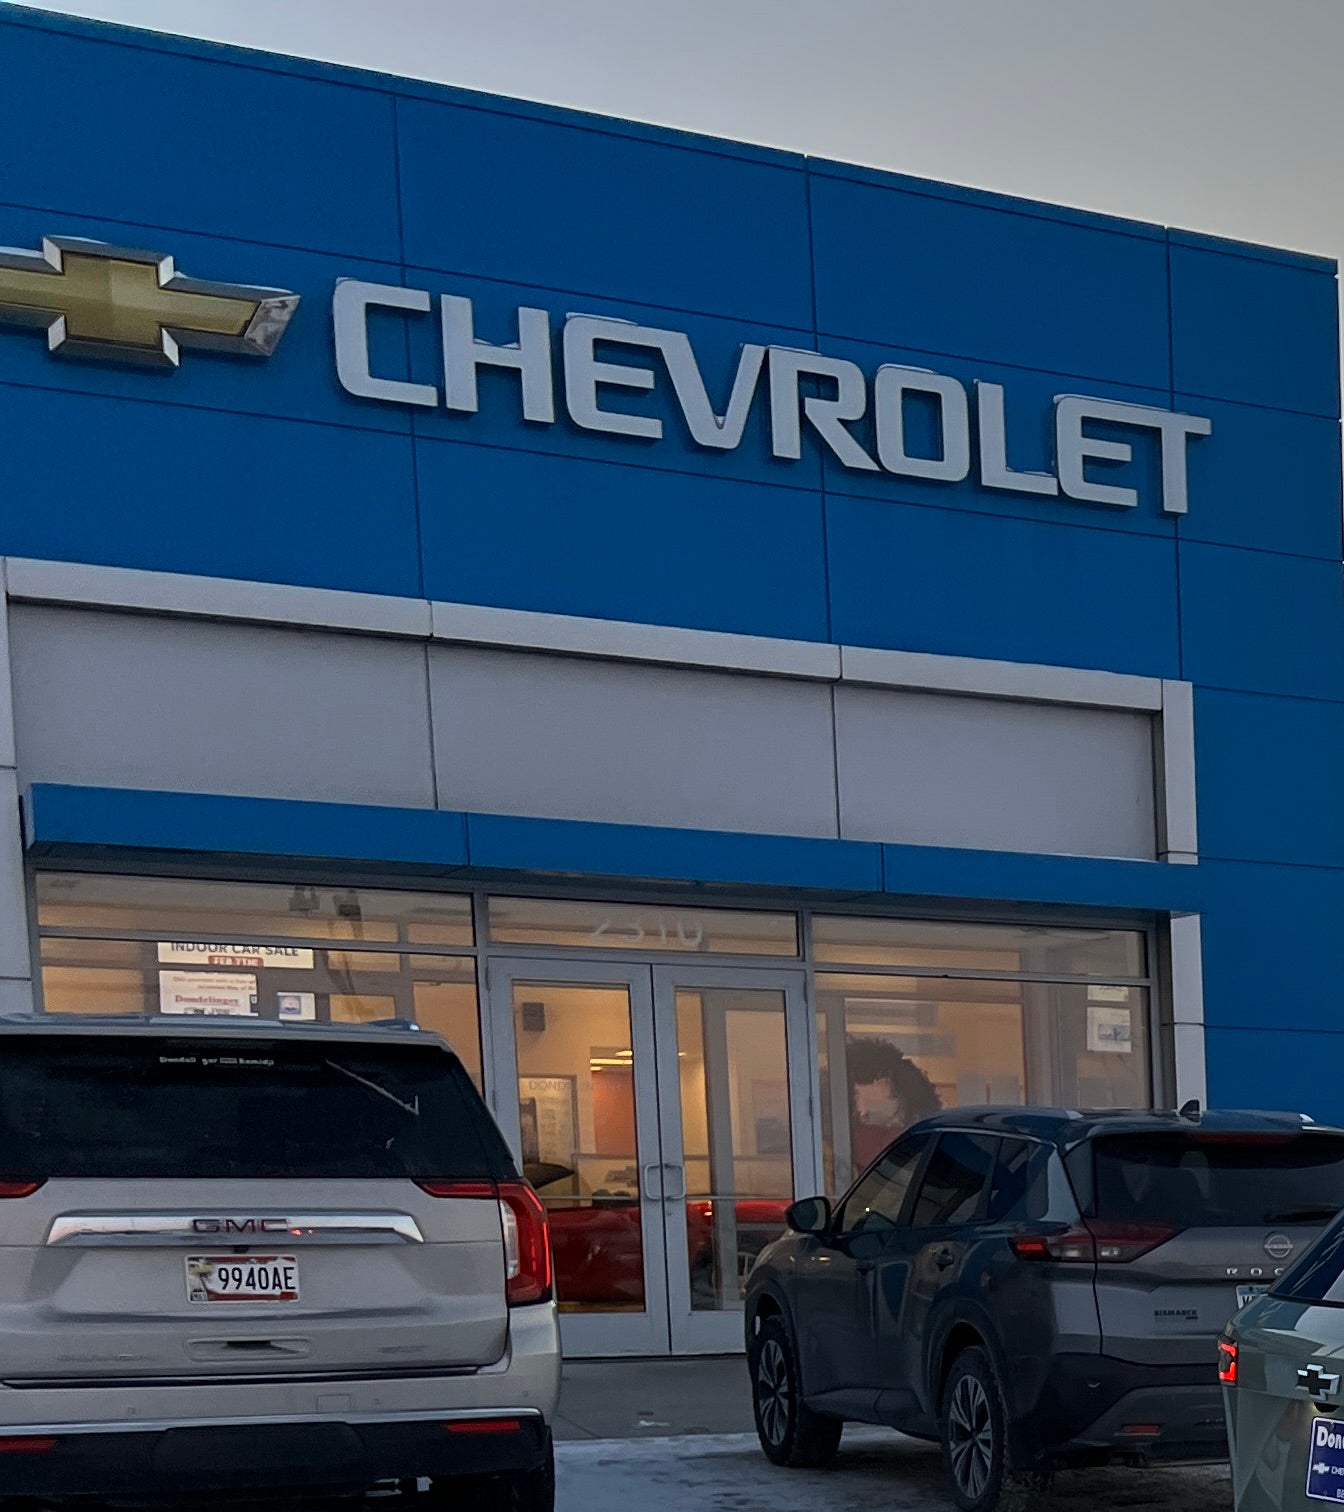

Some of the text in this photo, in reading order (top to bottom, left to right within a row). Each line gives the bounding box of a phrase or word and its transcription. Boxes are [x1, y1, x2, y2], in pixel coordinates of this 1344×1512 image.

[333, 276, 1212, 514] CHEVROLET
[171, 942, 299, 956] INDOOR CAR SALE
[193, 1218, 288, 1232] GMC
[218, 1267, 296, 1290] 9940AE
